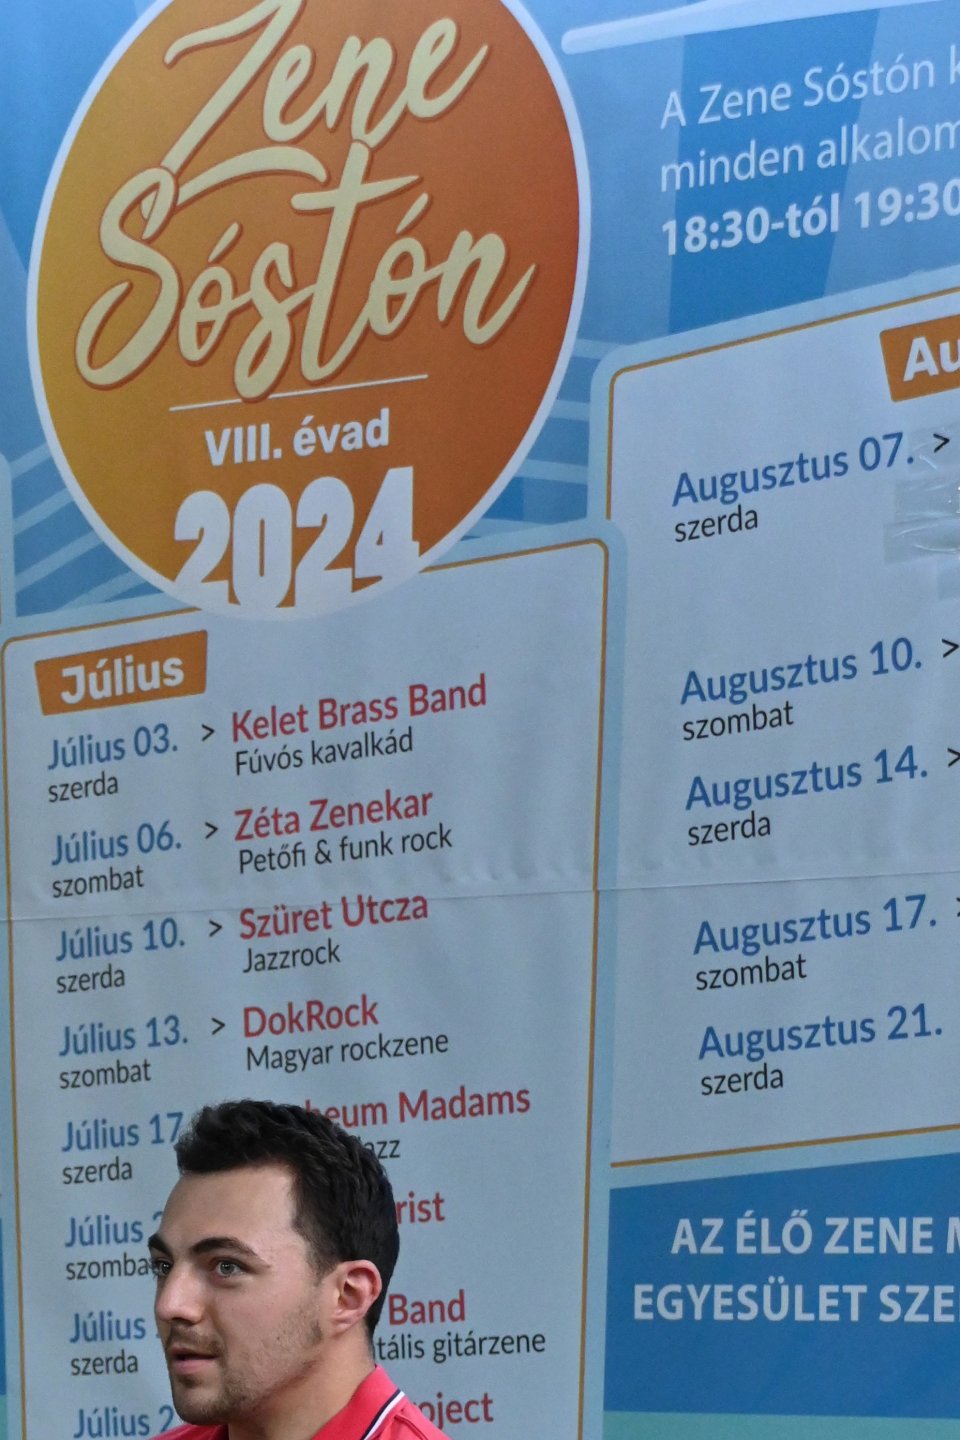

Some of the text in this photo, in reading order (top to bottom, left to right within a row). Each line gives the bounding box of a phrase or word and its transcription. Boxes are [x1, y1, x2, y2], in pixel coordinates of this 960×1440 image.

[142, 0, 489, 218] Zene
[660, 97, 687, 130] A
[698, 83, 792, 125] Zene
[803, 53, 935, 107] Sóstón
[660, 141, 805, 193] minden
[660, 178, 960, 256] 18:30-tól 19:30
[75, 141, 536, 400] Sóstón
[205, 408, 390, 467] VIII. évad
[672, 432, 914, 506] Augusztus 07.
[172, 466, 420, 609] 2024
[674, 505, 759, 543] szerda
[60, 655, 185, 704] Július
[681, 637, 922, 705] Augusztus 10.
[47, 674, 487, 772] Július 03. Kelet Brass Band
[683, 701, 794, 741] szombat
[235, 727, 414, 776] Fúvós kavalkád
[48, 772, 119, 803] szerda
[686, 745, 928, 810] Augusztus 14.
[51, 789, 434, 868] Július 06. Zéta Zenekar
[238, 823, 452, 875] Petőfi & funk rock
[688, 810, 771, 846] szerda
[52, 865, 144, 898] szombat
[55, 893, 429, 963] Július 10. Szüret Utcza
[693, 894, 937, 957] Augusztus 17.
[56, 965, 126, 994] szerda
[242, 940, 341, 974] Jazzrock
[695, 953, 807, 991] szombat
[58, 994, 379, 1058] Július 13. DokRock
[699, 1003, 943, 1063] Augusztus 21.
[59, 1061, 152, 1089] szombat
[246, 1031, 449, 1075] Magyar rockzene
[701, 1062, 784, 1096] szerda
[62, 1116, 140, 1153] Július
[149, 1111, 184, 1144] 17
[398, 1086, 531, 1123] Madams
[62, 1156, 133, 1185] szerda
[65, 1214, 144, 1248] Július
[396, 1190, 446, 1225] rist
[671, 1217, 725, 1255] AZ
[736, 1207, 813, 1256] ÉLŐ
[824, 1216, 934, 1254] ZENE
[66, 1252, 150, 1281] szomba
[69, 1289, 465, 1344] Július Band
[633, 1276, 960, 1323] EGYESÜLET SZE
[70, 1350, 139, 1377] szerda
[373, 1331, 546, 1364] tális gitárzene
[73, 1392, 494, 1438] Július 2 oject
